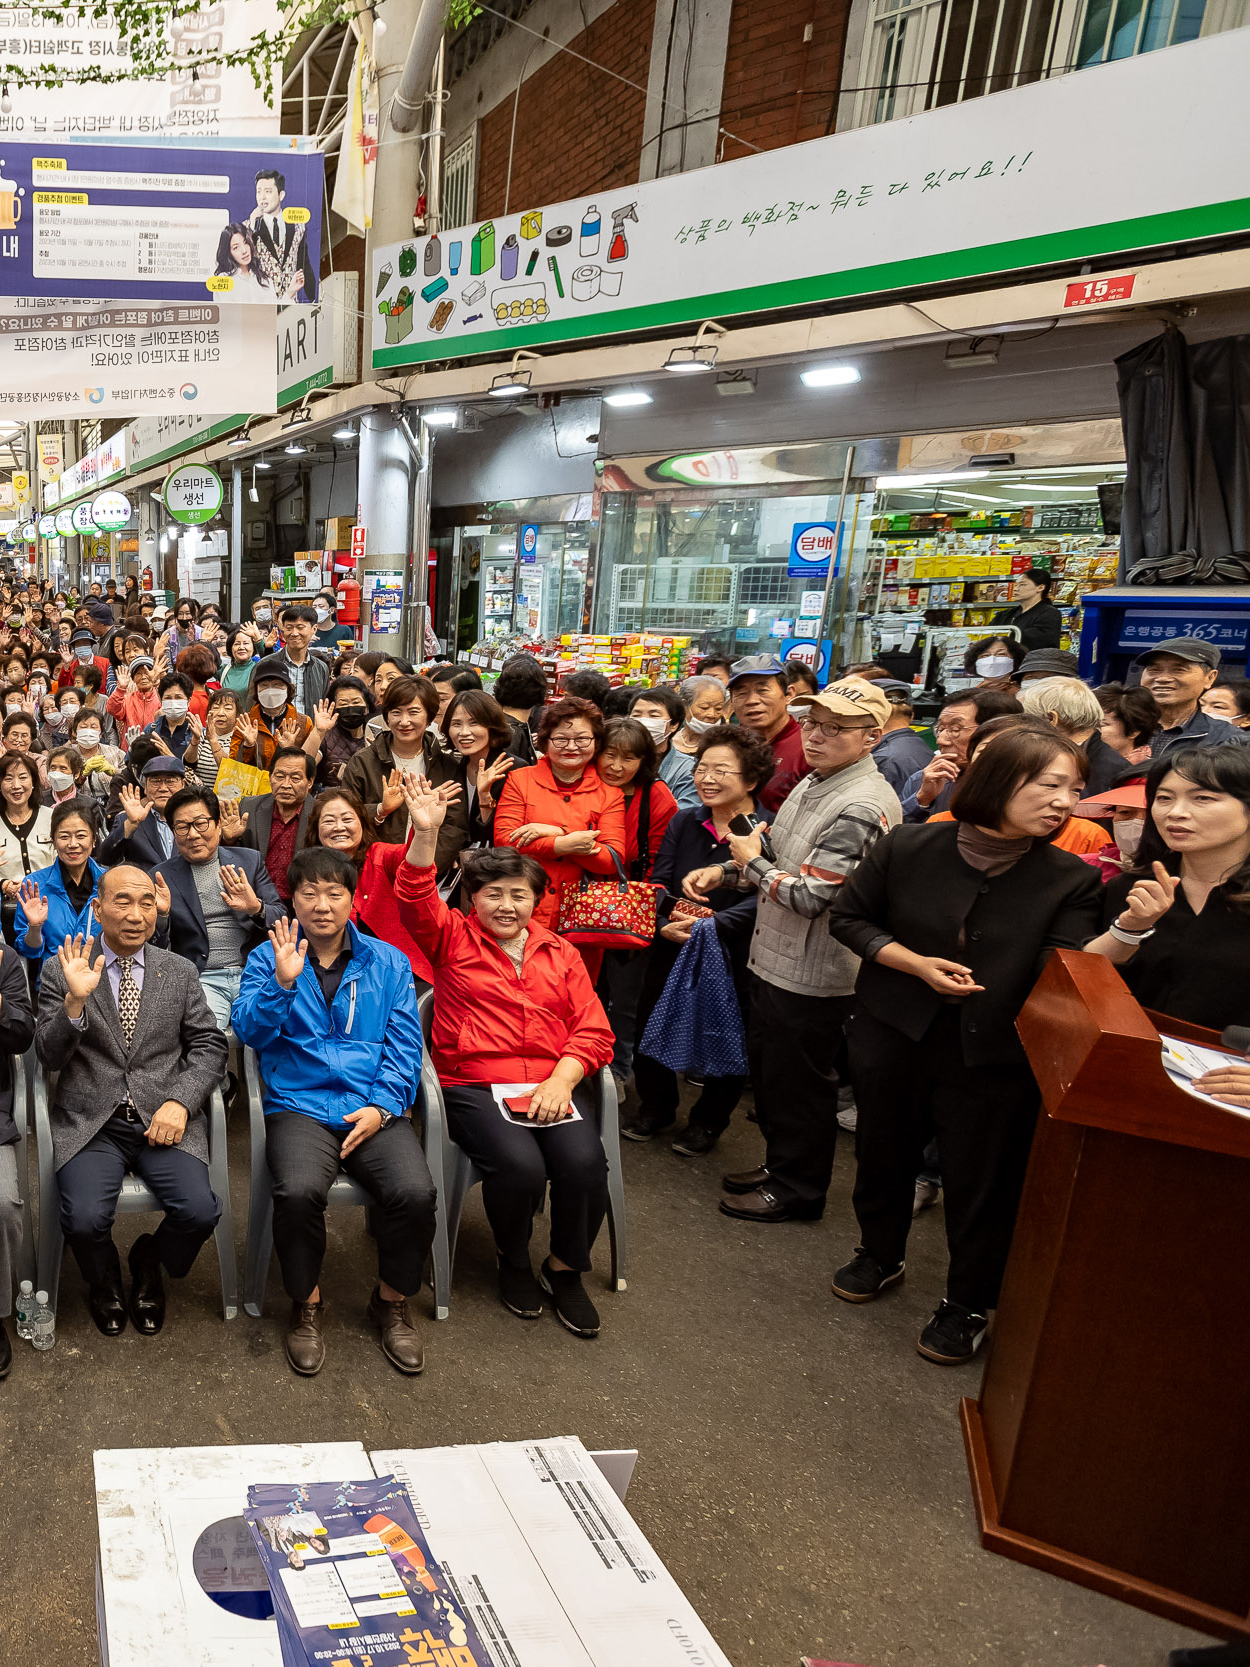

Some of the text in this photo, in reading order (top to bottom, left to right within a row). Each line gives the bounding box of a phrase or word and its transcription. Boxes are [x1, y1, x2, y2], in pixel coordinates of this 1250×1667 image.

[36, 159, 64, 170] 맥주축제
[37, 194, 85, 205] 경품추첨 이벤트
[675, 217, 732, 245] 상품의
[888, 180, 910, 197] 다
[2, 236, 19, 259] 내
[1083, 280, 1109, 299] 15
[276, 305, 322, 376] ART
[172, 477, 215, 492] 우리마트
[183, 492, 204, 506] 생선
[187, 511, 201, 520] 생선
[801, 536, 833, 551] 담배
[1124, 623, 1248, 640] 은행공동 365 코너
[387, 1533, 405, 1547] BEER
[365, 1642, 401, 1655] 2023.10.17
